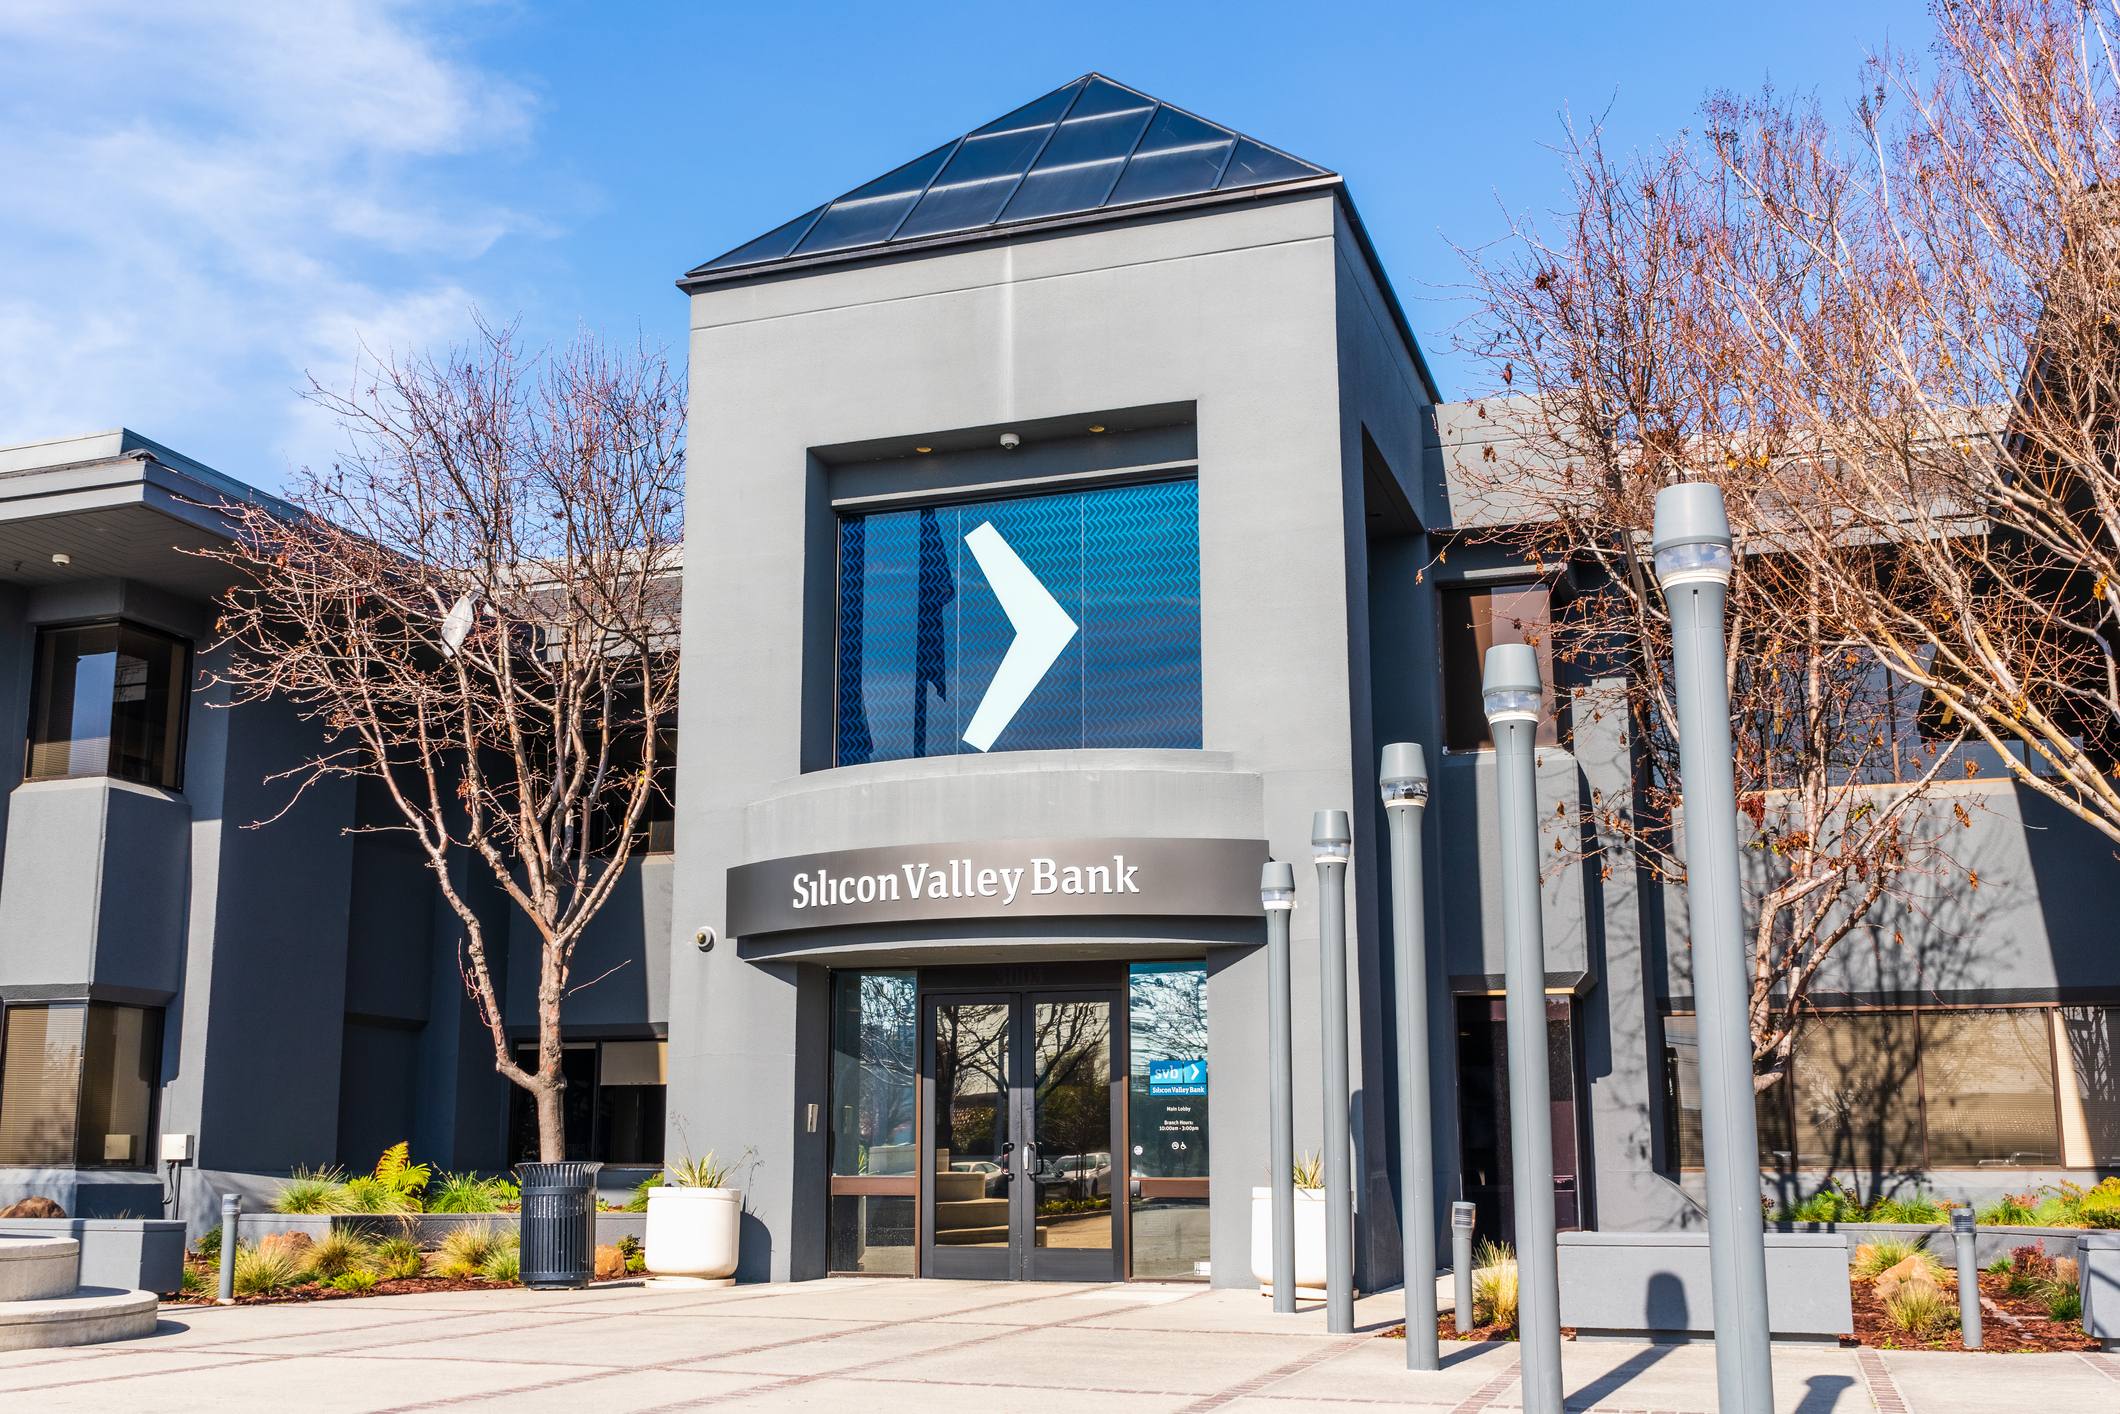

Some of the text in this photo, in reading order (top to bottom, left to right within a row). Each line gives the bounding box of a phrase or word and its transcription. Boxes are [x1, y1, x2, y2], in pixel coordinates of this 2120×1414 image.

[793, 855, 1141, 909] Silicon Valley Bank
[1154, 1064, 1179, 1080] svb
[1152, 1086, 1171, 1094] Silicon
[1171, 1086, 1189, 1095] Valley
